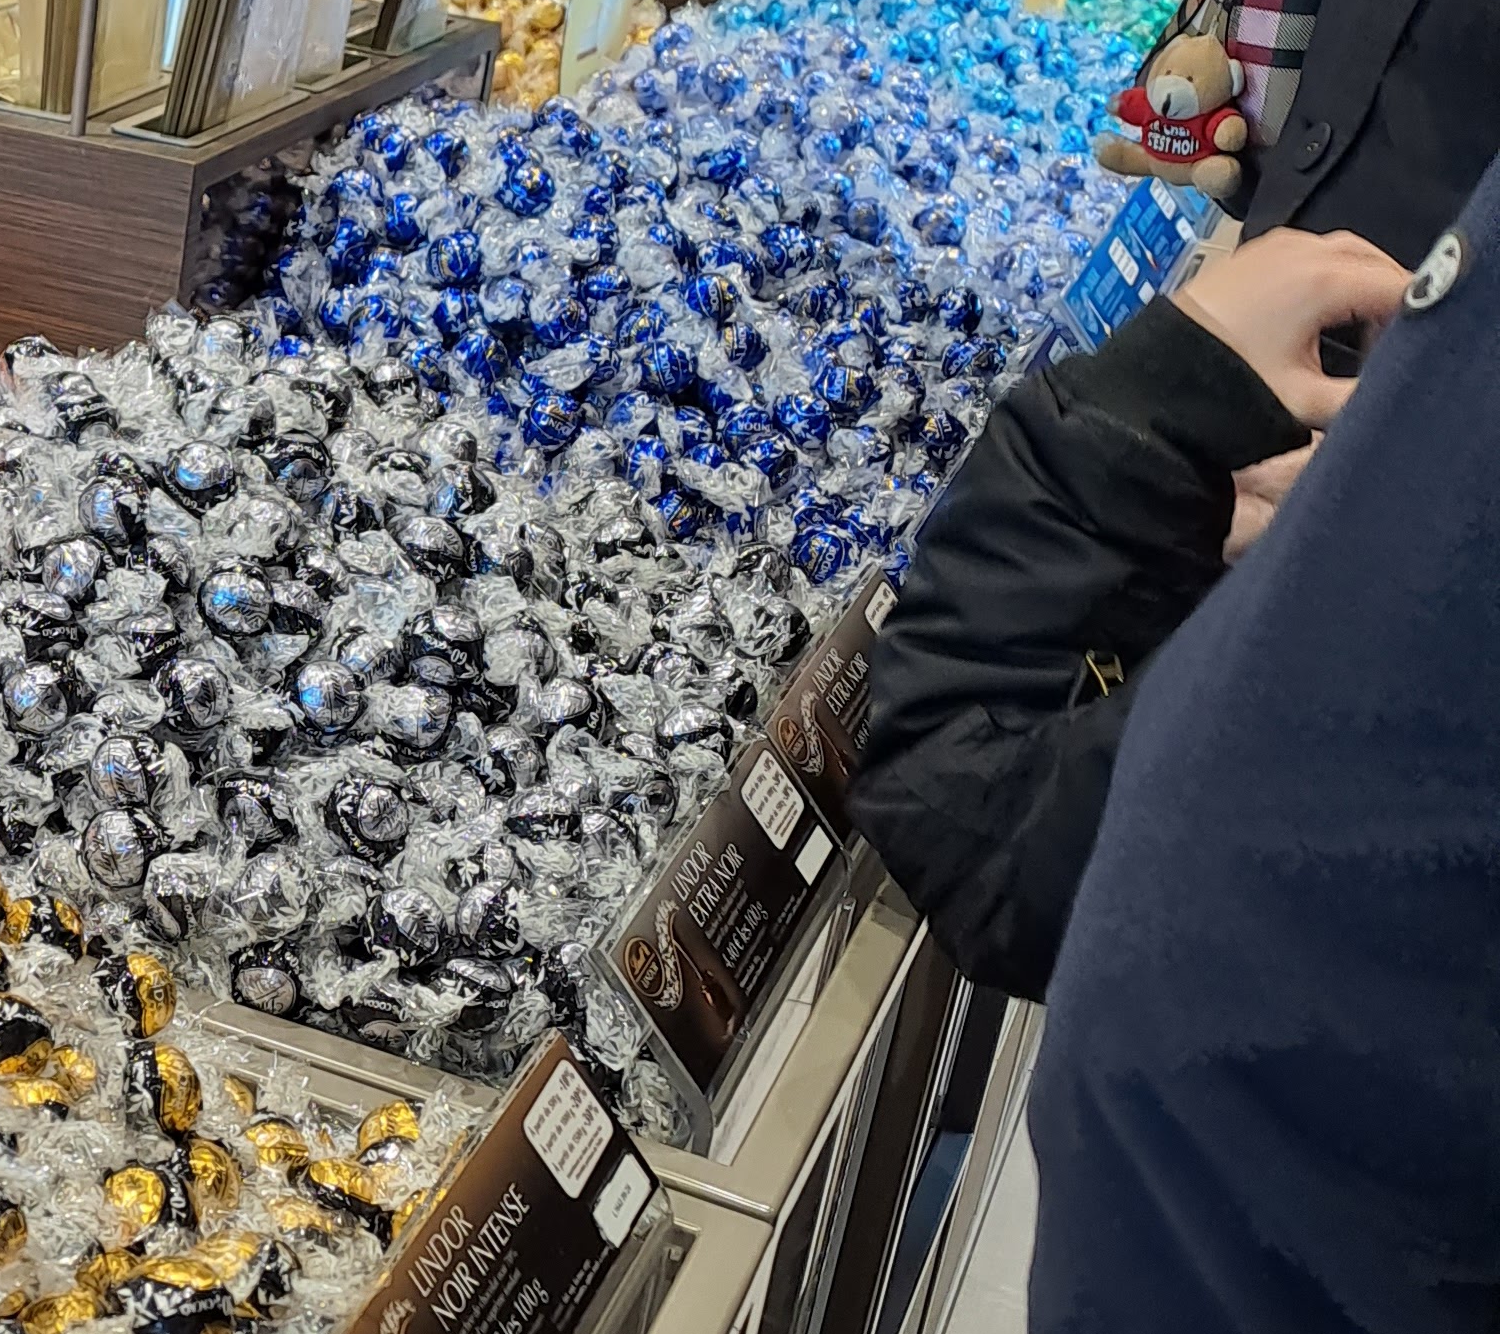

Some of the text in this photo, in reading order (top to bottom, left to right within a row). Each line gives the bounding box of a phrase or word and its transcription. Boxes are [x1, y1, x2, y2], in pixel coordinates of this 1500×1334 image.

[809, 645, 845, 695] LINDOR
[667, 838, 716, 902] LINDOR
[685, 873, 726, 929] EXTRA
[710, 841, 746, 889] NOIR
[405, 1200, 475, 1299] LINDOR
[428, 1256, 481, 1334] NOIR
[465, 1180, 531, 1278] INTENSE
